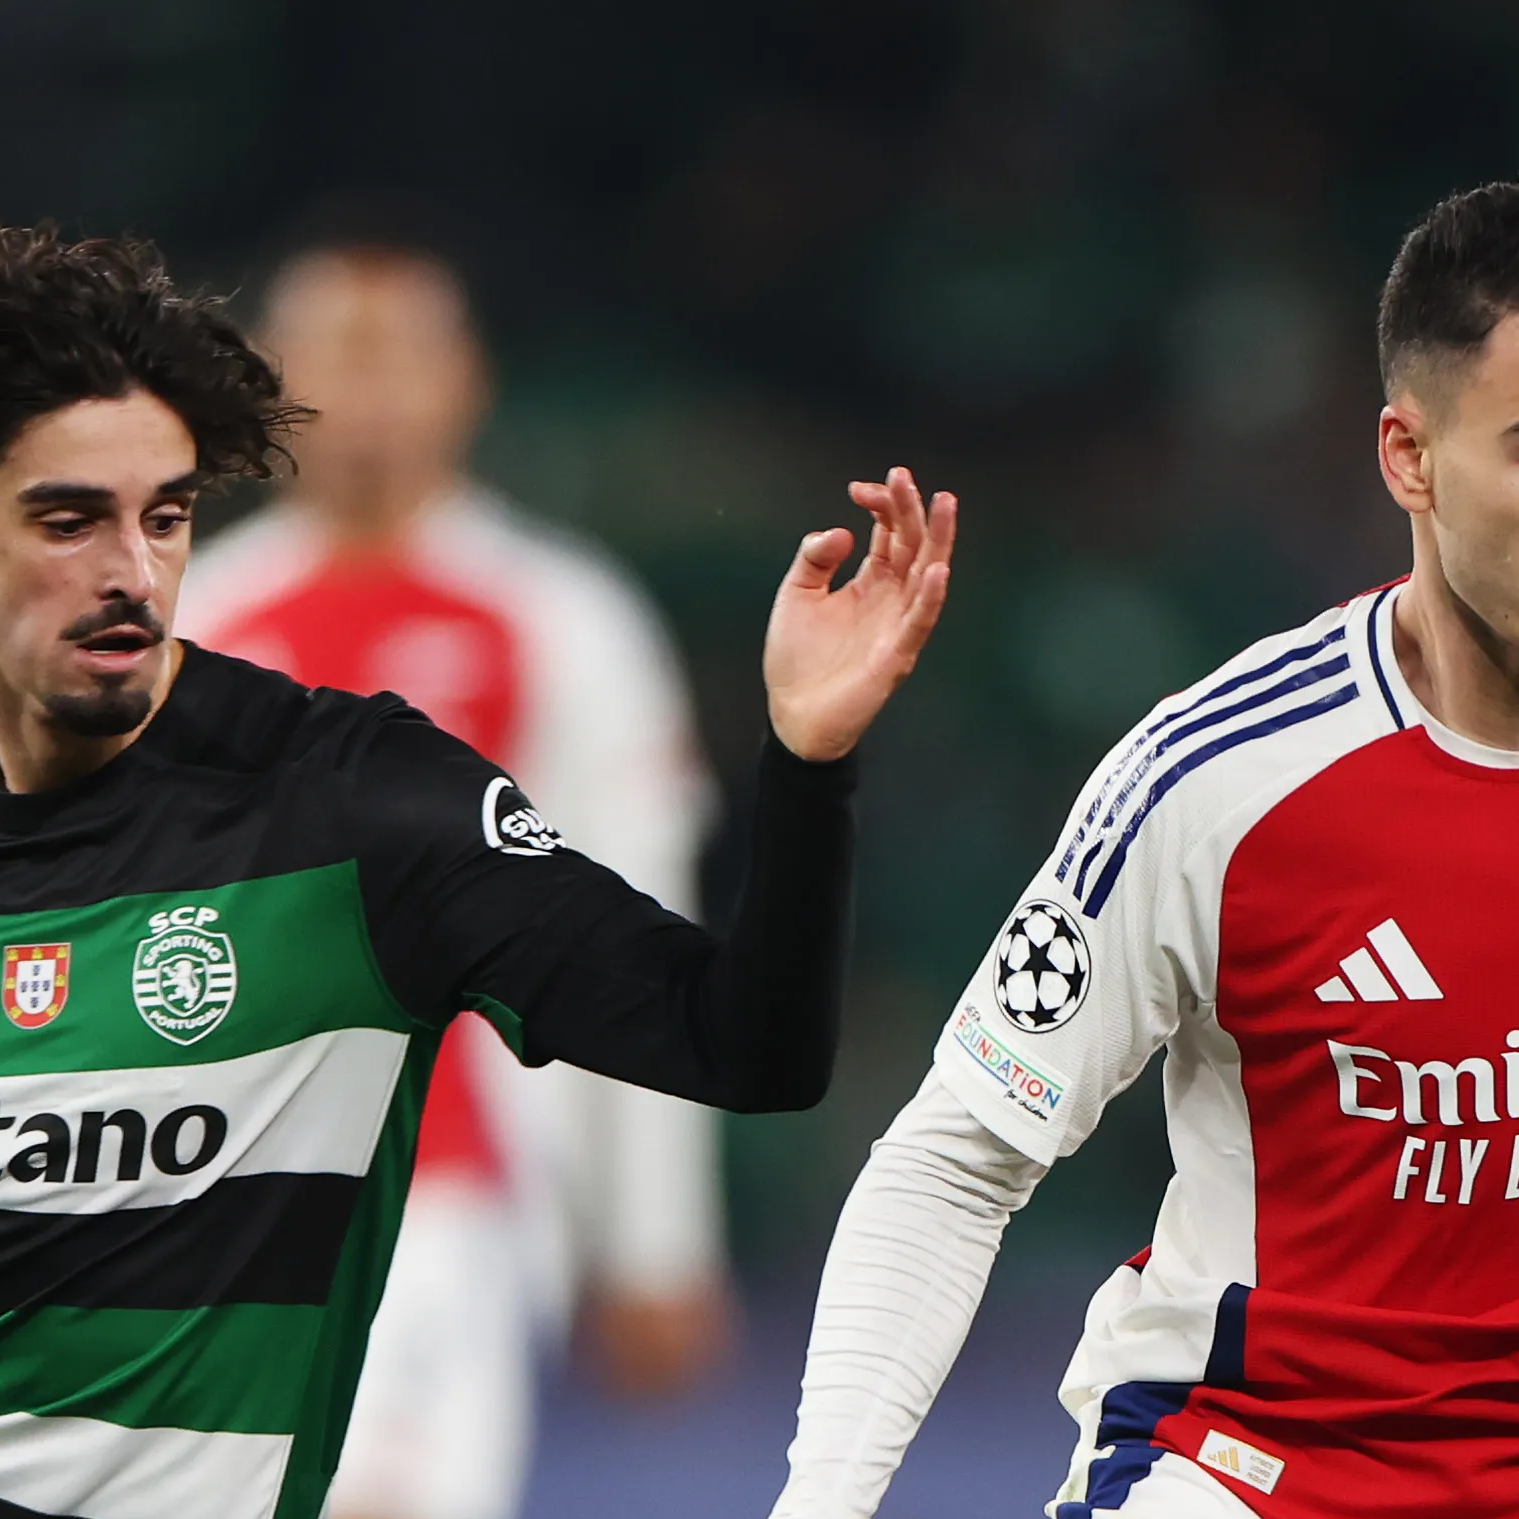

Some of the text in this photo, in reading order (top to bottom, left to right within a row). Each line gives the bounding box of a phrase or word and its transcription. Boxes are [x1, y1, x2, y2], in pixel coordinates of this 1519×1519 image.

[148, 906, 219, 934] SCP
[142, 935, 224, 967] SPORTING
[1392, 1136, 1489, 1205] FLY
